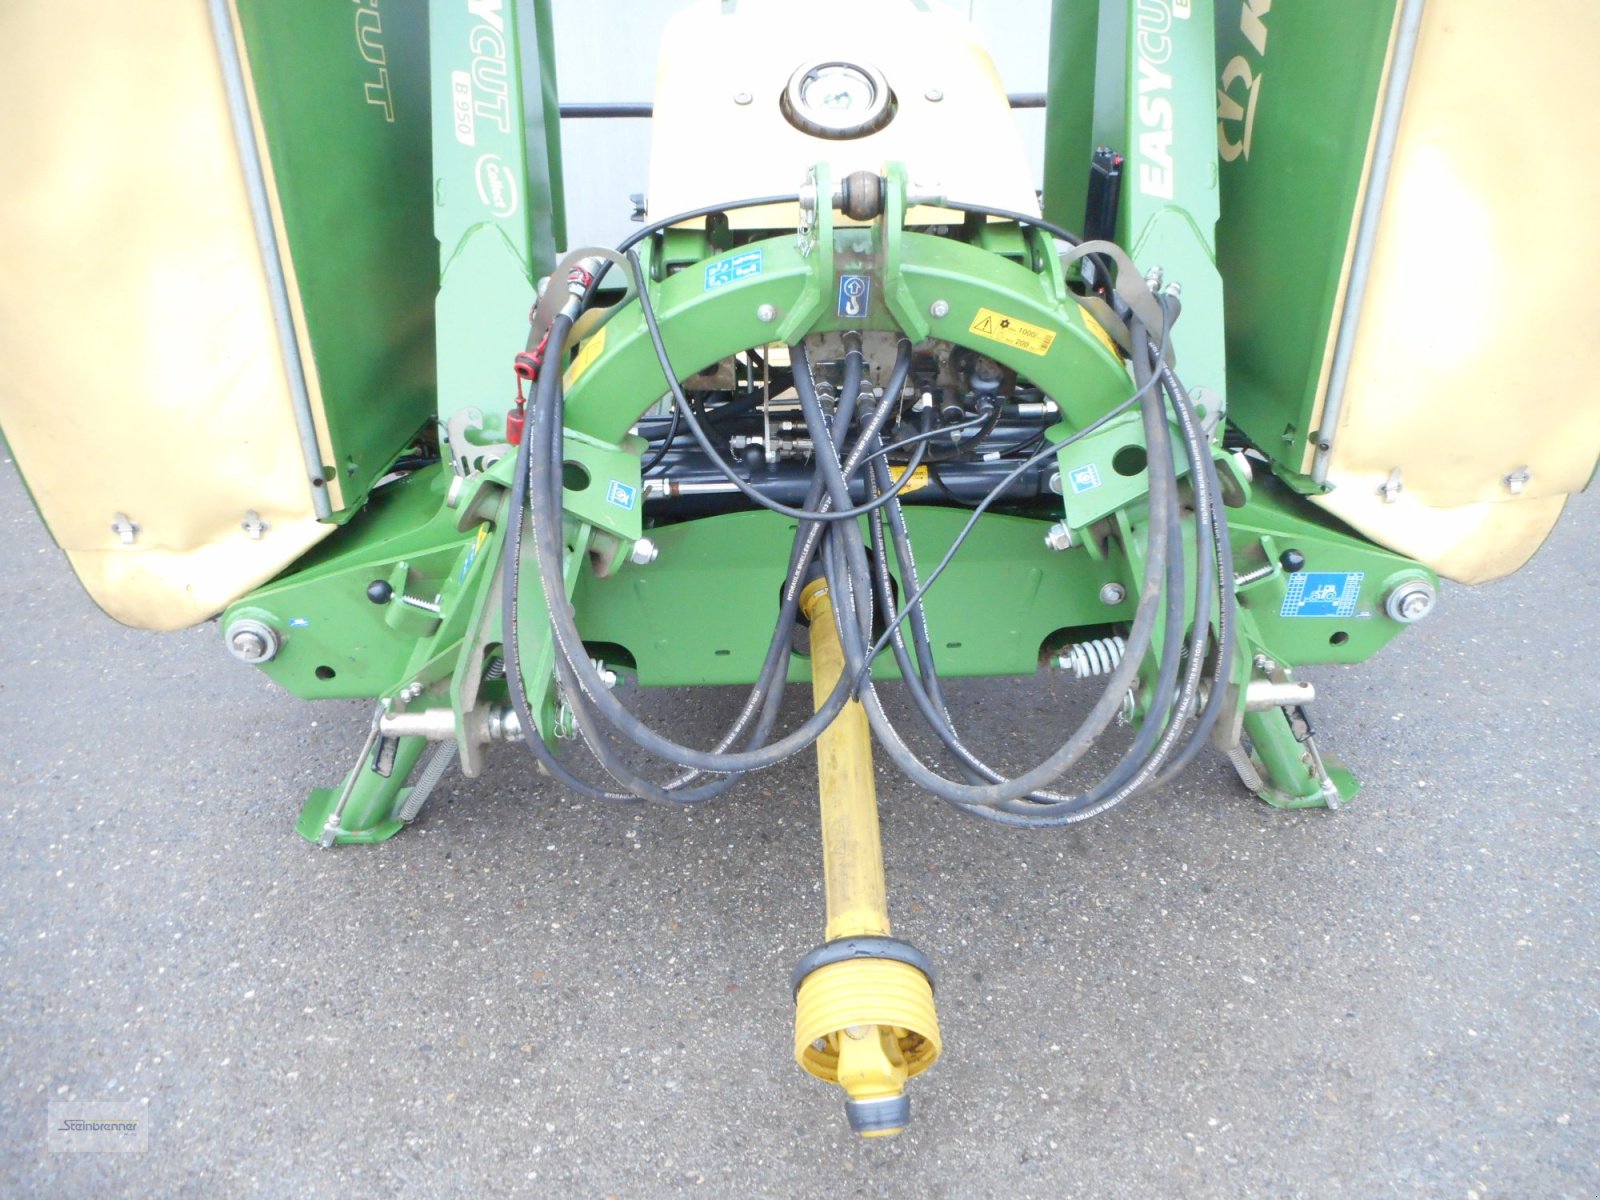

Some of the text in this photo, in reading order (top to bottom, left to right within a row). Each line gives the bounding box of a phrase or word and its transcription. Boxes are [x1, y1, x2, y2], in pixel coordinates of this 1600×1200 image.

[356, 0, 395, 123] UT
[455, 82, 472, 135] B 950
[1066, 807, 1104, 824] HYDRAULIK
[1103, 788, 1131, 810] MUELLER
